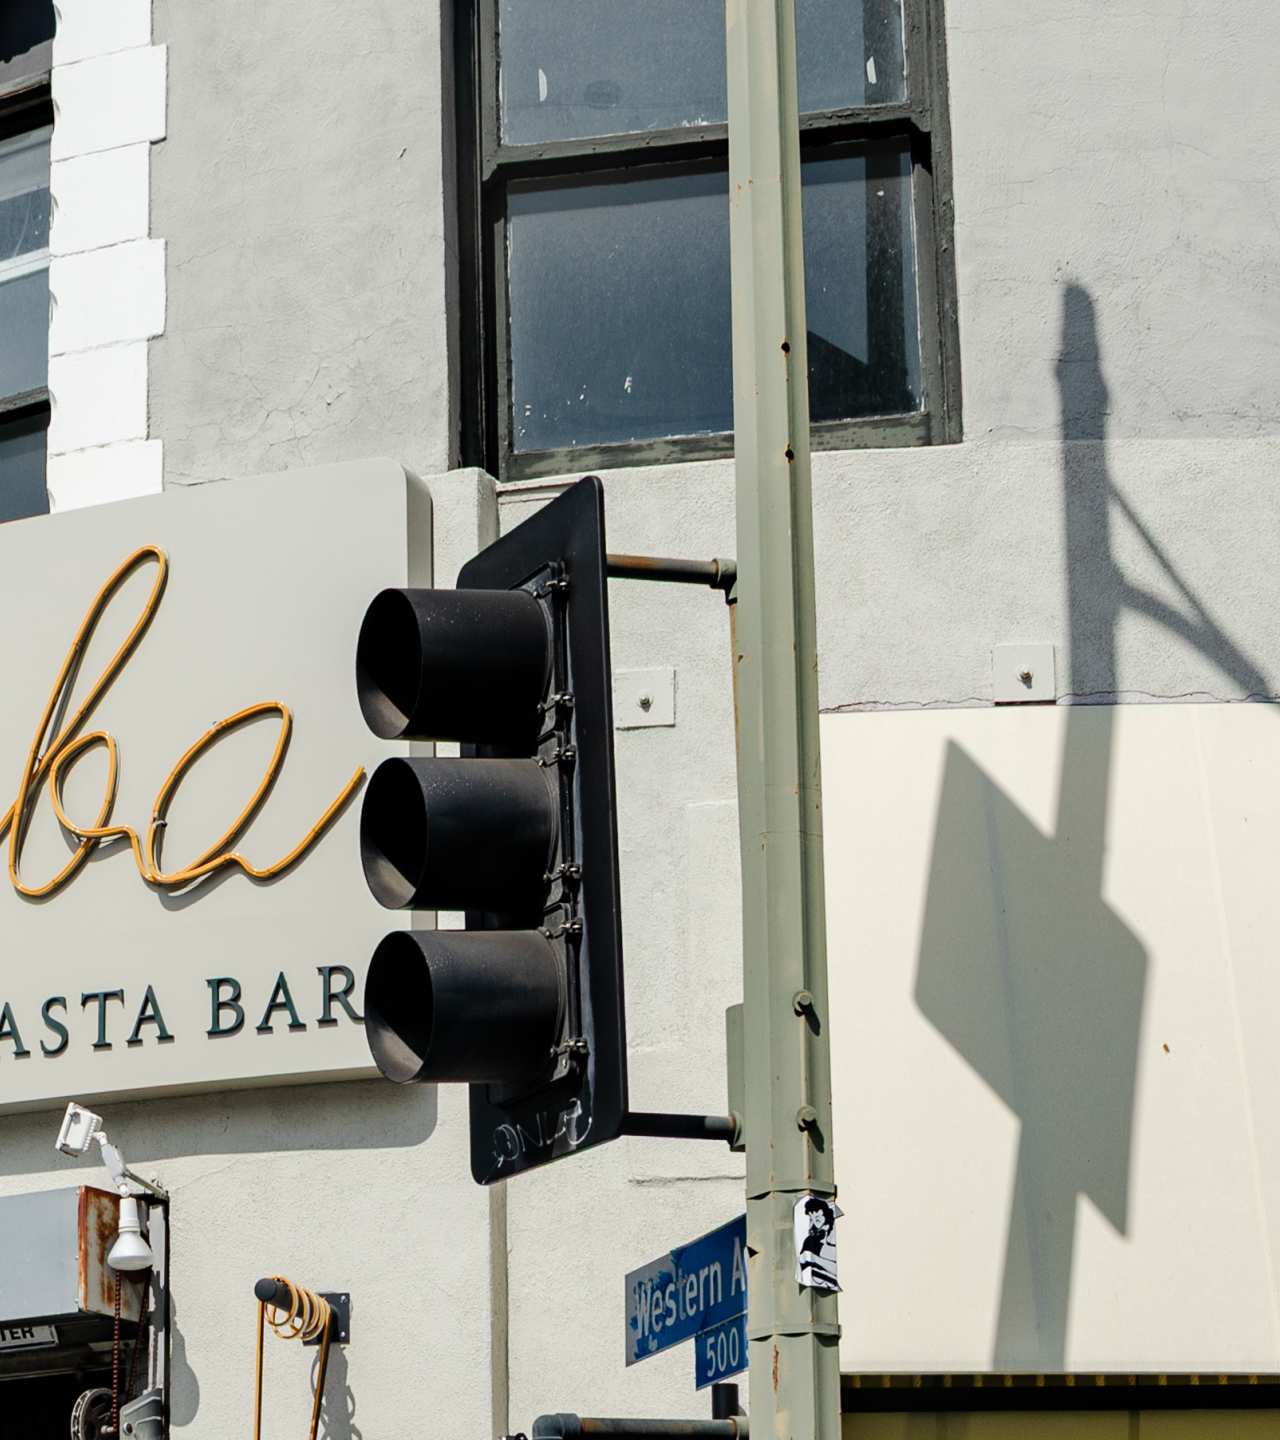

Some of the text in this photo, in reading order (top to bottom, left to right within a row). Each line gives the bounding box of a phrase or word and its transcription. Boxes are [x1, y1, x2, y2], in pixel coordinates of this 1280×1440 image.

[205, 963, 368, 1042] BAR
[634, 1260, 723, 1338] Western
[706, 1326, 740, 1378] 500
